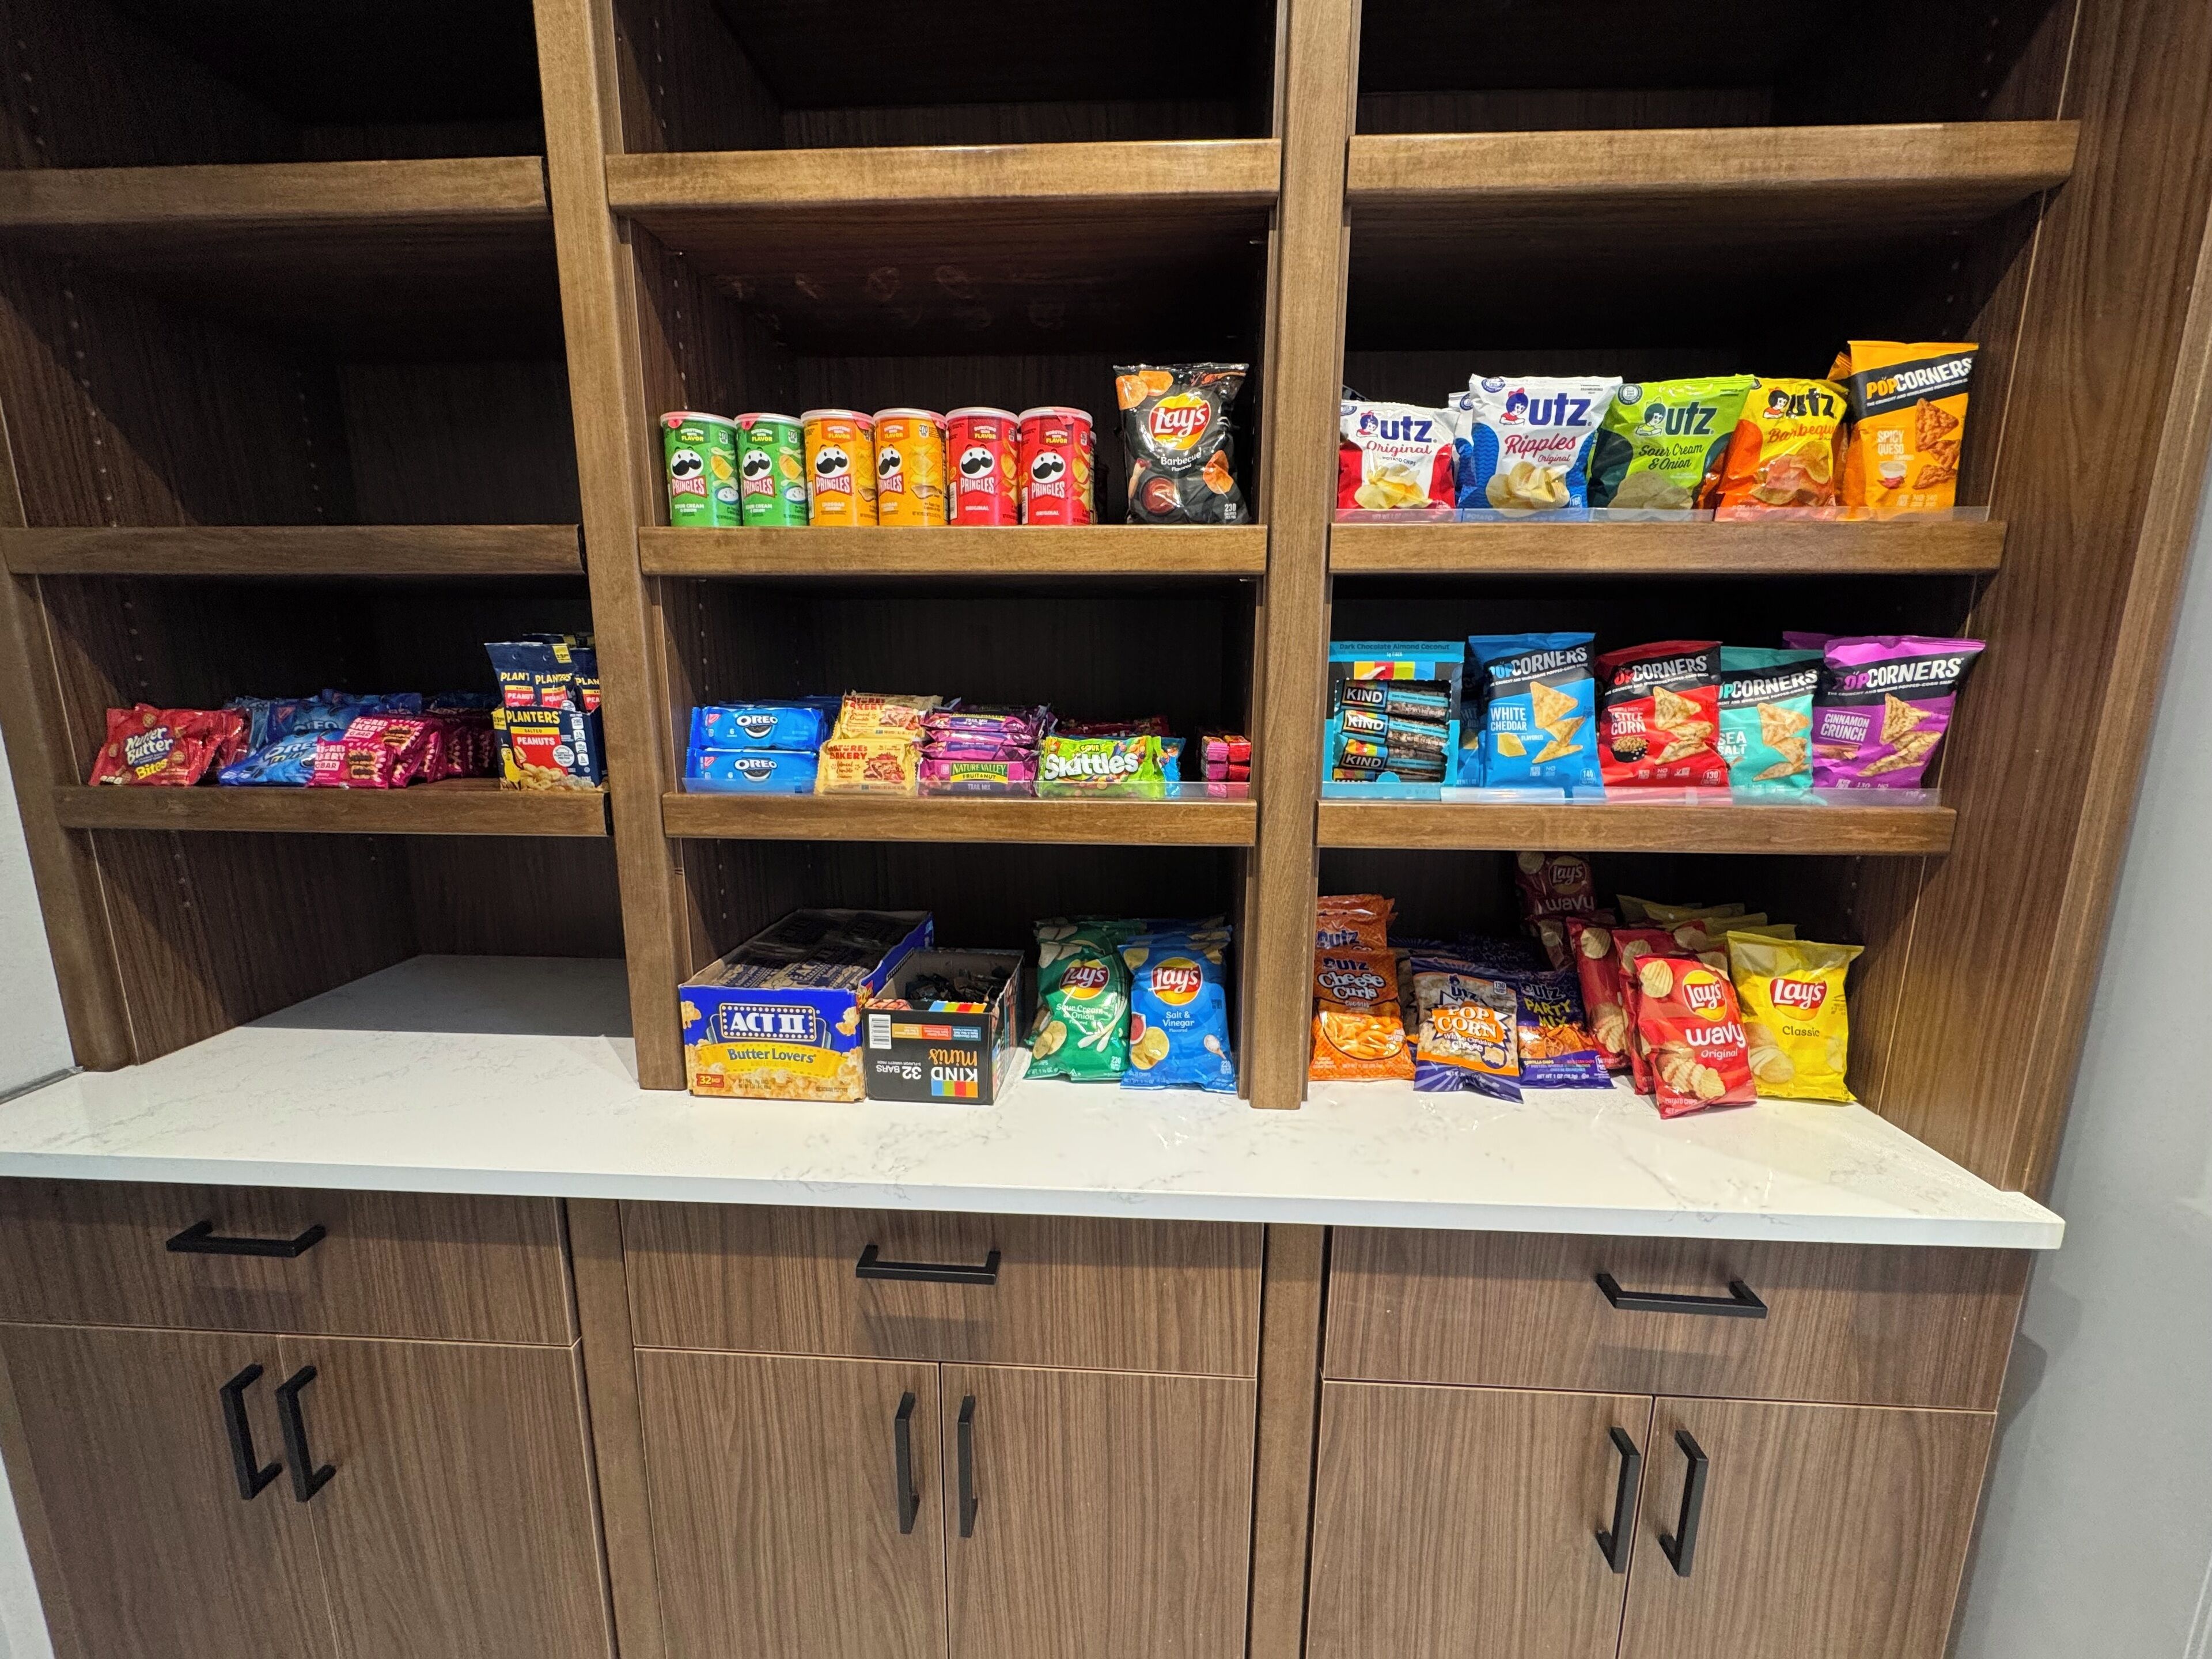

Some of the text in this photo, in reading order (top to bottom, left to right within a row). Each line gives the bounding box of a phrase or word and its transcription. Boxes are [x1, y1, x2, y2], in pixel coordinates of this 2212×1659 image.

[1866, 358, 1972, 400] POPCORNERS
[1529, 393, 1591, 426] utz
[1786, 388, 1835, 417] utz
[1154, 406, 1207, 437] Lay's
[1665, 402, 1718, 435] utz
[1380, 416, 1433, 443] utz
[1877, 430, 1904, 443] SPICY
[1366, 441, 1432, 457] Original
[1505, 433, 1576, 459] Ripples
[1639, 444, 1703, 456] Sour Cream
[1877, 443, 1904, 455] QUESO
[1161, 448, 1201, 466] Barbecue
[1538, 454, 1570, 464] Original
[1649, 457, 1691, 470] & Onion
[672, 478, 704, 494] PRINGLES
[744, 478, 773, 494] PRINGLES
[816, 476, 850, 493] PRINGLES
[960, 477, 994, 494] PRINGLES
[1032, 482, 1065, 498] PRINGLES
[1225, 503, 1236, 512] 230
[1571, 496, 1580, 505] 160
[1614, 655, 1707, 685] OPCORNERS
[1346, 688, 1382, 703] KIND
[506, 710, 560, 725] PLANTERS
[736, 715, 778, 726] OREO
[1348, 713, 1383, 730] KIND
[1490, 707, 1526, 721] WHITE
[1825, 714, 1870, 728] CINNAMON
[1491, 721, 1527, 732] CHEDDAR
[1611, 721, 1646, 736] CORN
[1820, 724, 1866, 741] CRUNCH
[125, 728, 167, 752] Nutter
[517, 737, 555, 745] PEANUTS
[1718, 731, 1747, 745] SEA
[127, 738, 173, 765] Butter
[265, 742, 317, 759] ORE
[1718, 744, 1747, 756] SALT
[734, 759, 777, 770] OREO
[952, 764, 1006, 774] NATURE VALLEY
[1044, 752, 1138, 779] Skittles
[1346, 755, 1381, 767] KIND
[135, 759, 168, 780] Bites
[1552, 866, 1583, 885] Lay's
[1546, 895, 1594, 911] wavy
[1329, 930, 1359, 947] utz
[1336, 960, 1369, 970] utz
[1062, 967, 1106, 988] Lay's
[1155, 968, 1198, 993] Lay's
[1318, 972, 1385, 988] Cheese
[1333, 986, 1378, 999] Curls
[1687, 983, 1722, 1009] Lay's
[1774, 979, 1824, 1010] Lay's
[1077, 1005, 1103, 1014] Cream
[1441, 1003, 1490, 1021] POP
[1525, 997, 1571, 1016] PARTY
[730, 1012, 805, 1033] ACT II
[1072, 1012, 1094, 1020] Onion
[1162, 1019, 1195, 1028] Vinegar
[1539, 1014, 1566, 1027] MIX
[1438, 1017, 1497, 1038] CORN
[1685, 1021, 1746, 1048] wavy
[1782, 1026, 1819, 1037] Classic
[728, 1048, 816, 1063] Butter Lovers
[929, 1049, 977, 1066] minis
[1701, 1048, 1738, 1060] Original
[699, 1075, 711, 1084] 32
[876, 1065, 922, 1079] 32 BARS
[931, 1067, 978, 1081] KIND
